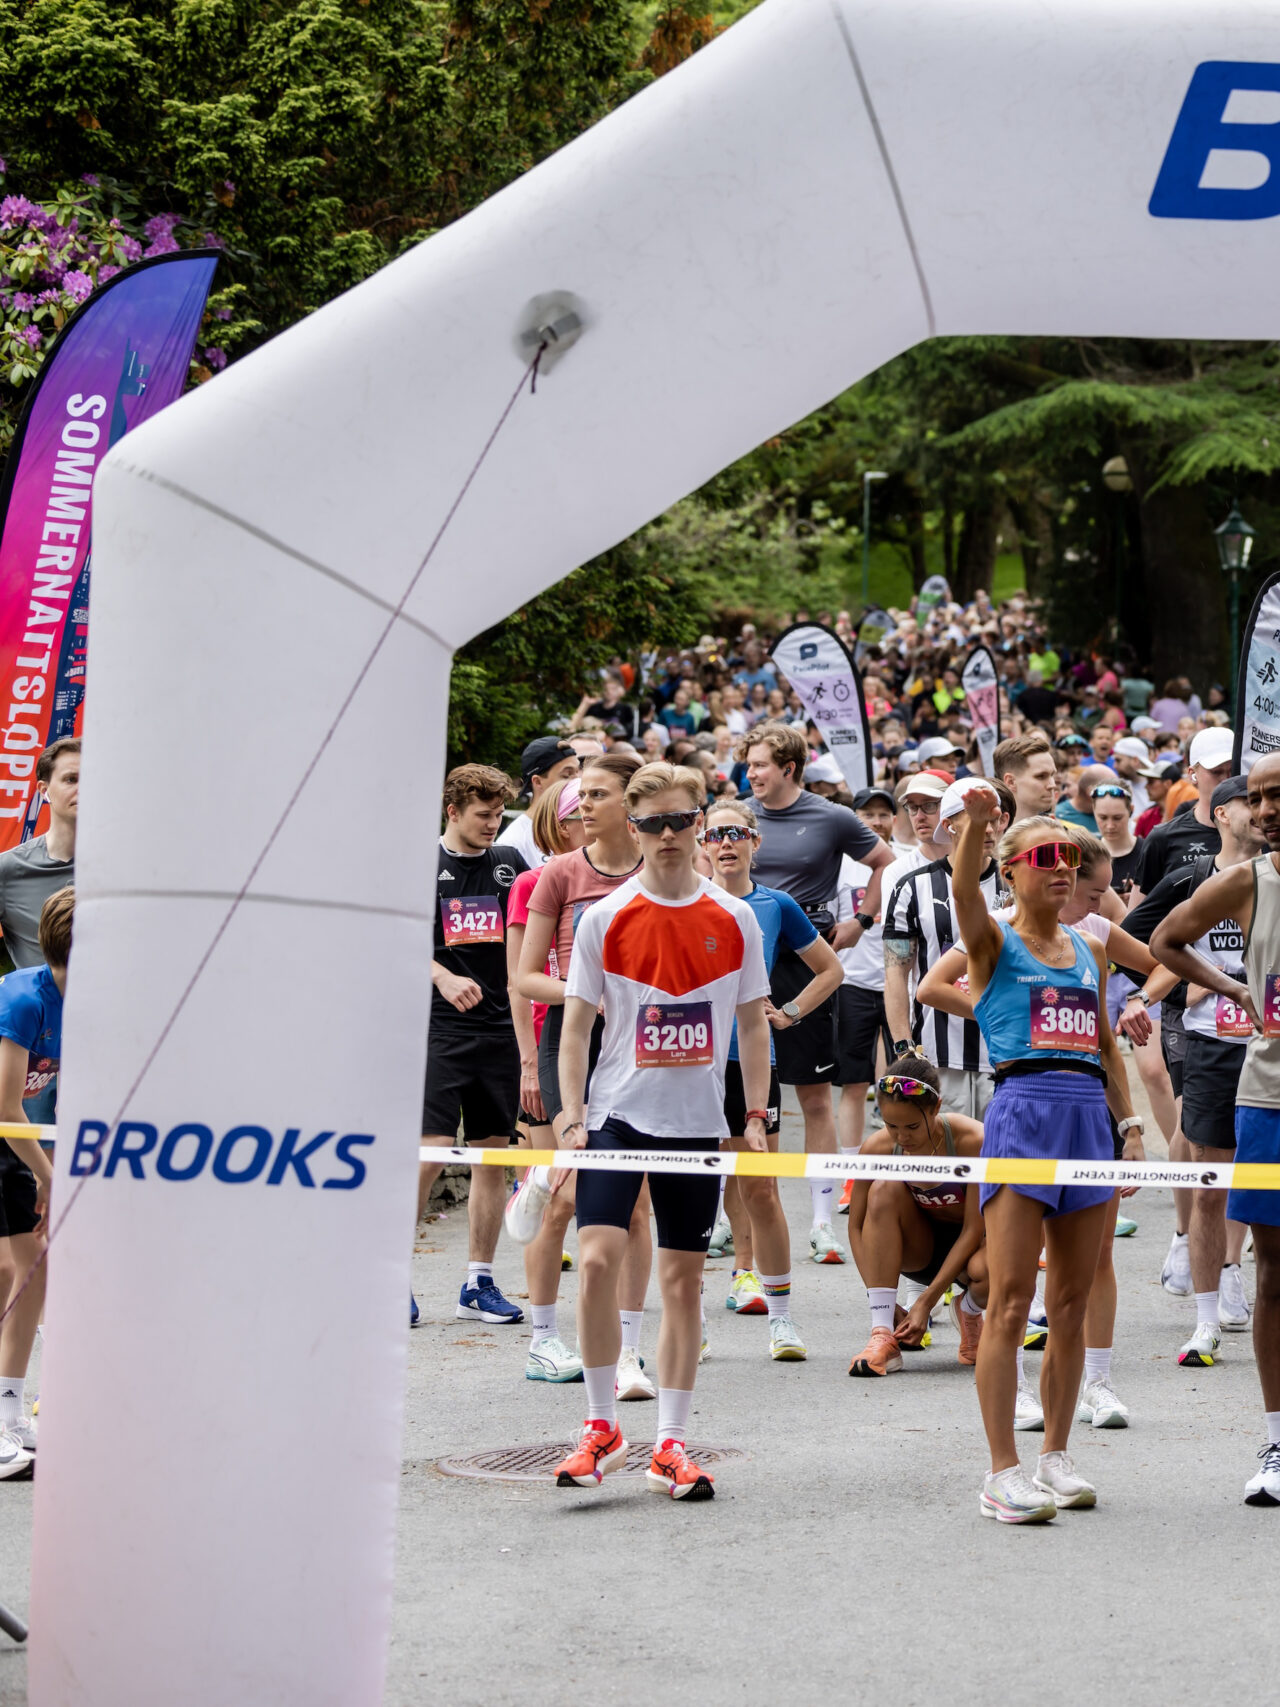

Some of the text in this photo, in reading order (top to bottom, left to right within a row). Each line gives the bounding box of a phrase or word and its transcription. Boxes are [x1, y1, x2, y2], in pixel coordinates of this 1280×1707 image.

[0, 393, 107, 823] SOMMERNATTSLØPET
[1253, 694, 1275, 716] 4:00
[449, 911, 498, 933] 3427
[1040, 1006, 1097, 1038] 3806
[643, 1021, 708, 1052] 3209
[72, 1121, 376, 1190] BROOKS
[825, 1162, 867, 1171] EVENT
[1073, 1170, 1116, 1180] EVENT
